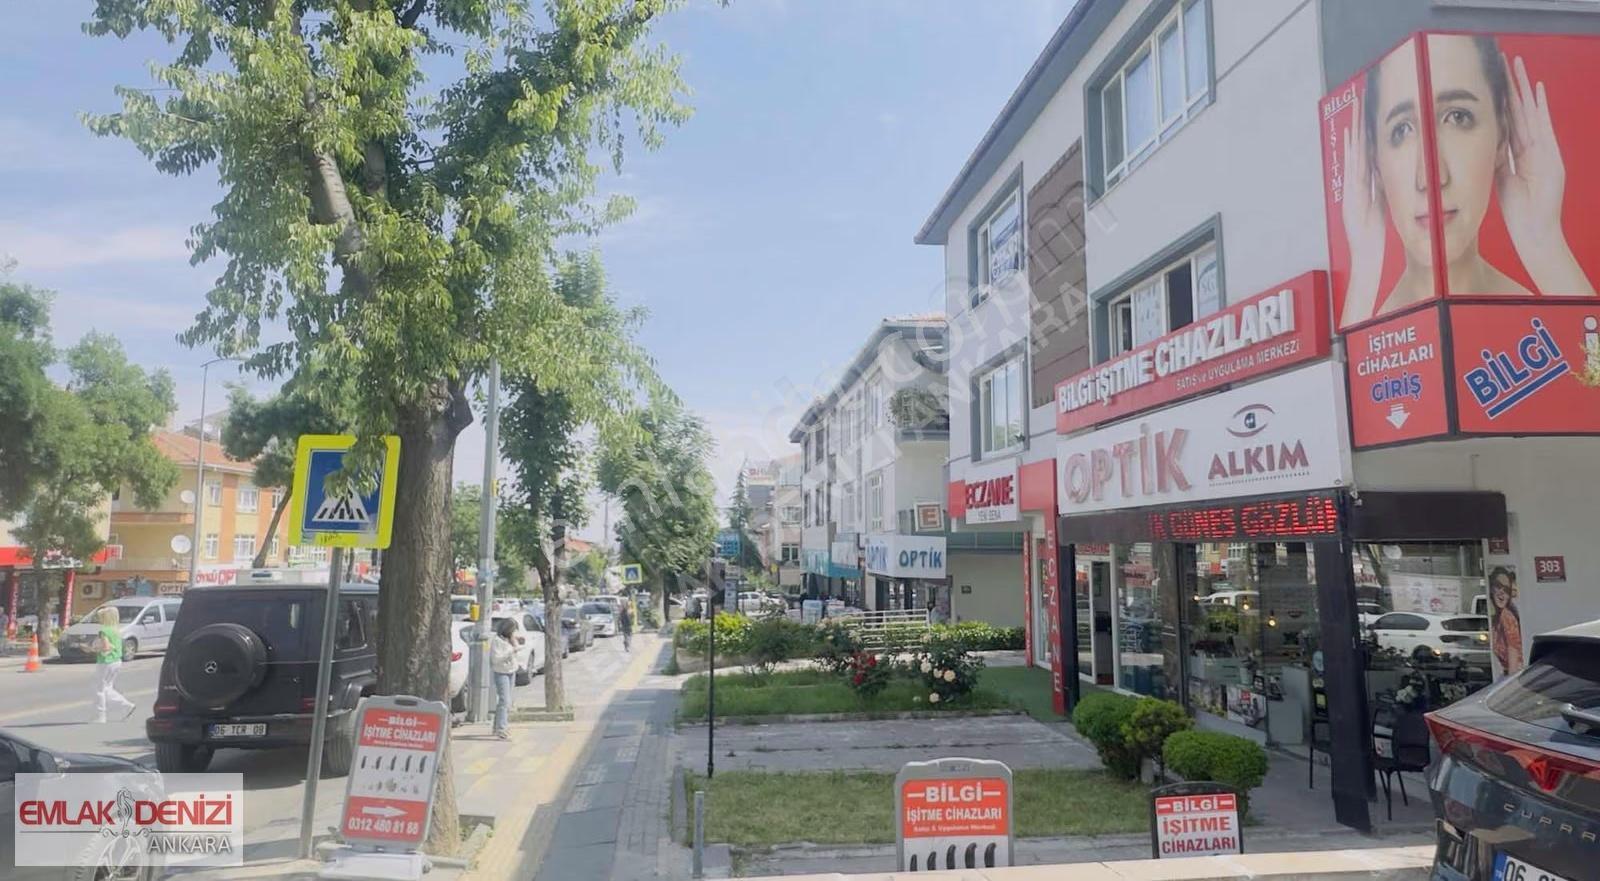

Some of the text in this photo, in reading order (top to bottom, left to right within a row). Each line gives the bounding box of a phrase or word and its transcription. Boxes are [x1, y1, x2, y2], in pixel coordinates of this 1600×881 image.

[1154, 288, 1296, 378] CİHAZLARI
[1367, 325, 1417, 354] İŞİTME
[1256, 338, 1301, 365] MERKEZİ
[1356, 343, 1434, 377] CİHAZLARI
[1463, 317, 1563, 406] BİLGİ
[1371, 371, 1422, 402] GİRİŞ
[1063, 423, 1193, 504] OPTİK
[1207, 439, 1310, 480] ALKIM
[965, 475, 1014, 509] ECZANE
[899, 546, 942, 569] OPTİK
[1540, 560, 1561, 573] 303
[1047, 530, 1061, 692] ECZANE
[363, 724, 394, 739] İŞİTME
[387, 714, 418, 727] BİLGİ
[925, 782, 983, 803] BİLGİ
[1172, 796, 1218, 813] BİLGİ
[348, 817, 373, 831] 0312
[907, 806, 1002, 824] İŞİTME CİHAZLARI
[1162, 816, 1232, 837] İŞİTME
[1502, 802, 1597, 843] CUPRA
[1162, 836, 1237, 855] CİHAZLARI
